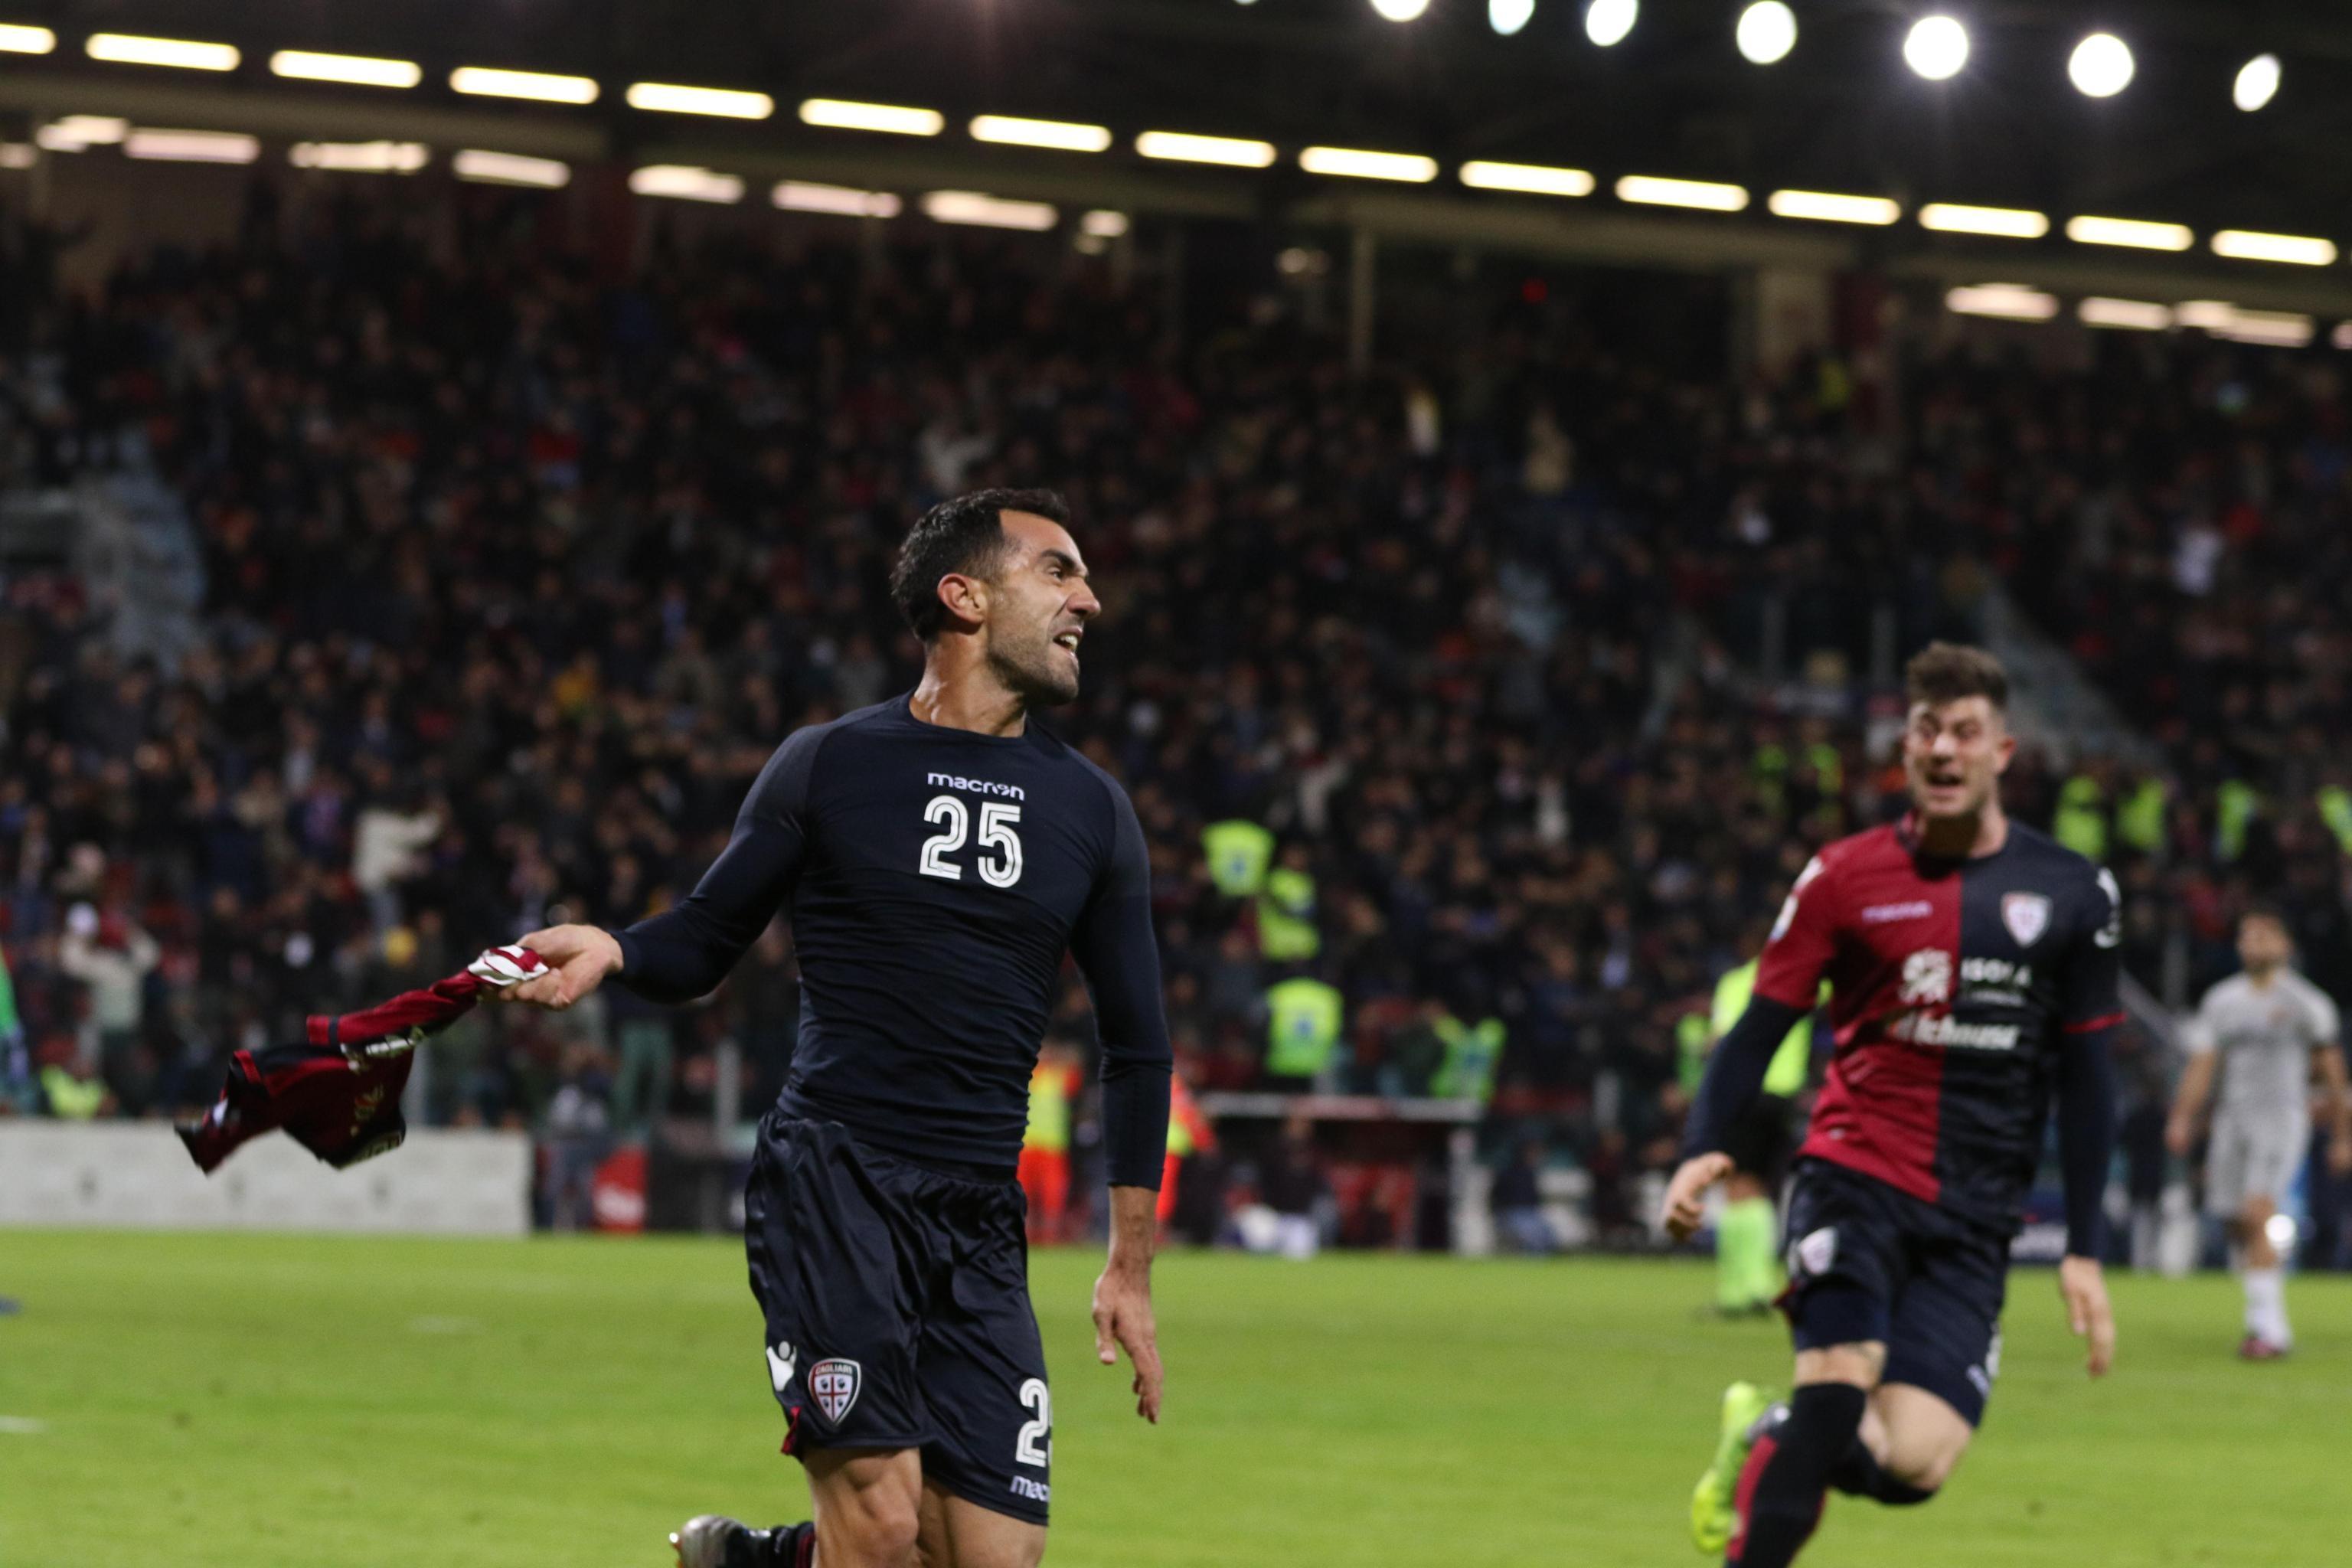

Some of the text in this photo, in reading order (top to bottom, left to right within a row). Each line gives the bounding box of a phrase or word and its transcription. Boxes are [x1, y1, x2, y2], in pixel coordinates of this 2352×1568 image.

[927, 772, 1025, 801] macron
[919, 795, 1024, 889] 25
[1015, 1377, 1053, 1468] 2
